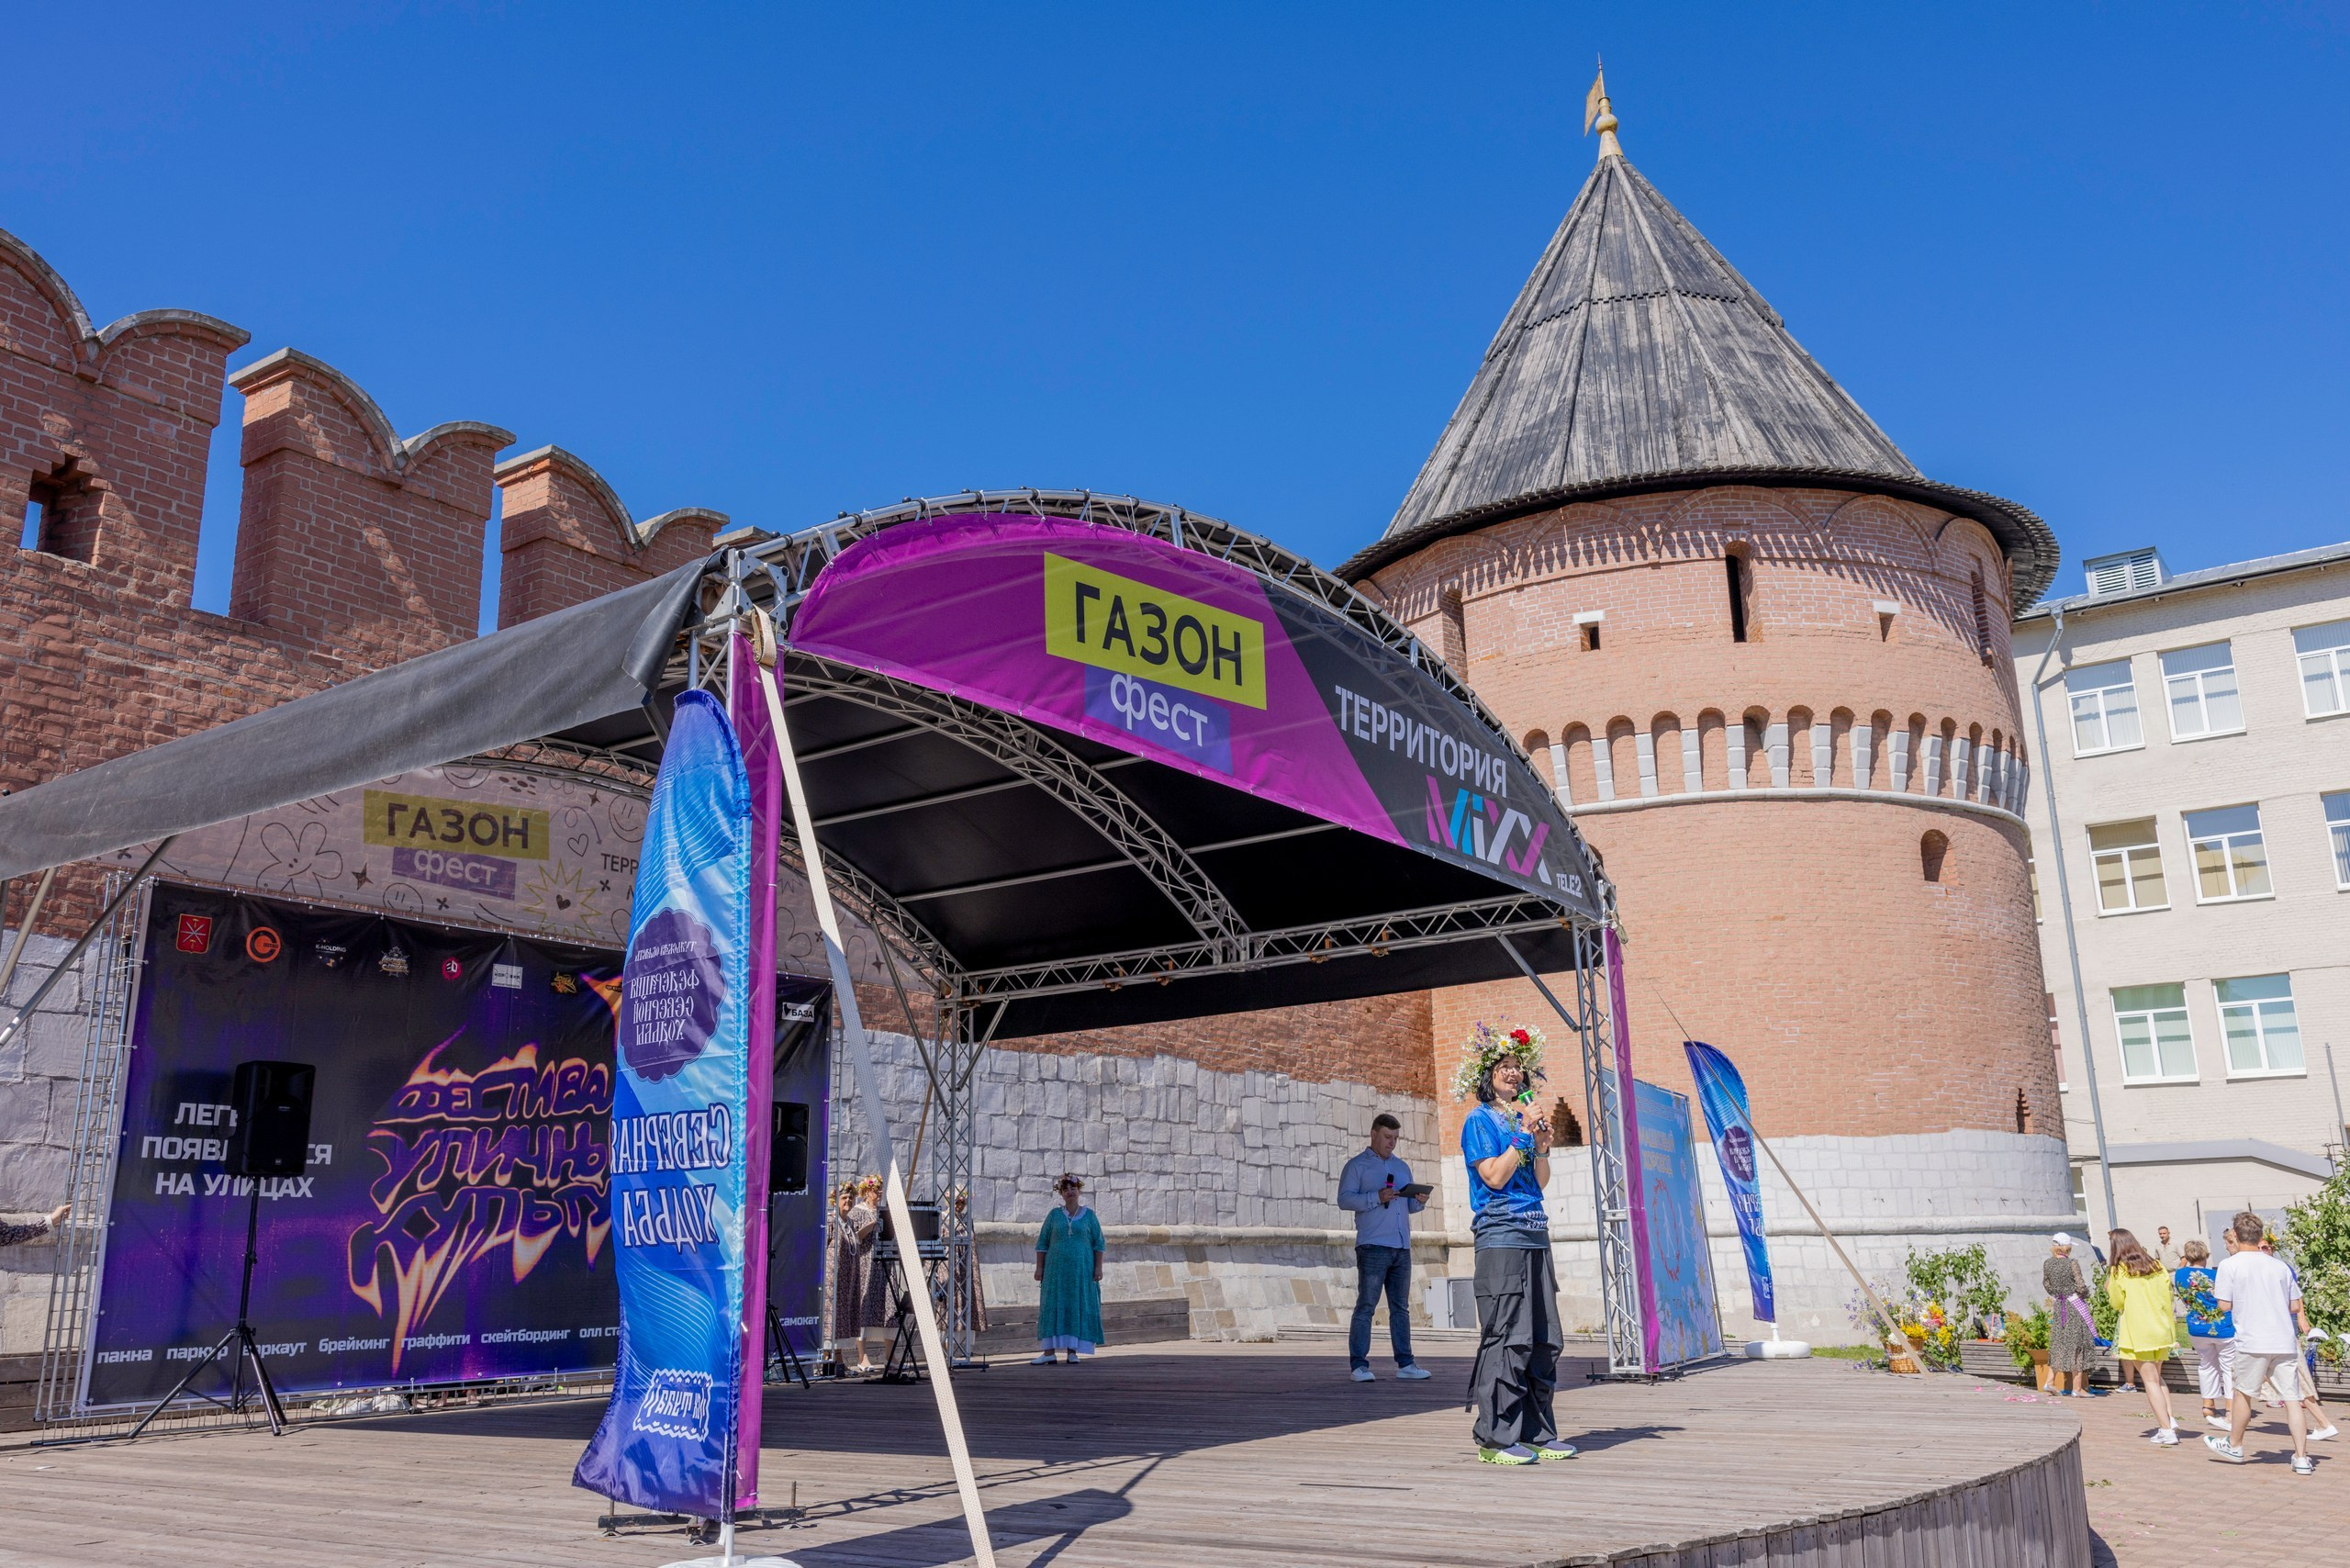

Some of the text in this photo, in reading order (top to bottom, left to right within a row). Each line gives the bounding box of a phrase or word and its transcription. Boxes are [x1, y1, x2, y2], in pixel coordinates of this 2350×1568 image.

[1075, 581, 1243, 687] ГАЗОН
[1110, 673, 1208, 747] фест
[1335, 685, 1507, 798] ТЕРРИТОРИЯ
[387, 802, 529, 849] ГАЗОН
[413, 848, 498, 886] фест
[1556, 873, 1583, 899] TELE2
[315, 944, 347, 953] K-HOLDING
[791, 1009, 813, 1018] БАЗА
[155, 1172, 315, 1201] НА УЛИЦАХ
[778, 1316, 820, 1327] самокат
[96, 1349, 153, 1364] панна
[318, 1336, 390, 1353] брейкинг
[401, 1333, 471, 1351] граффити
[481, 1327, 571, 1346] скейтбординг
[579, 1327, 602, 1338] олл
